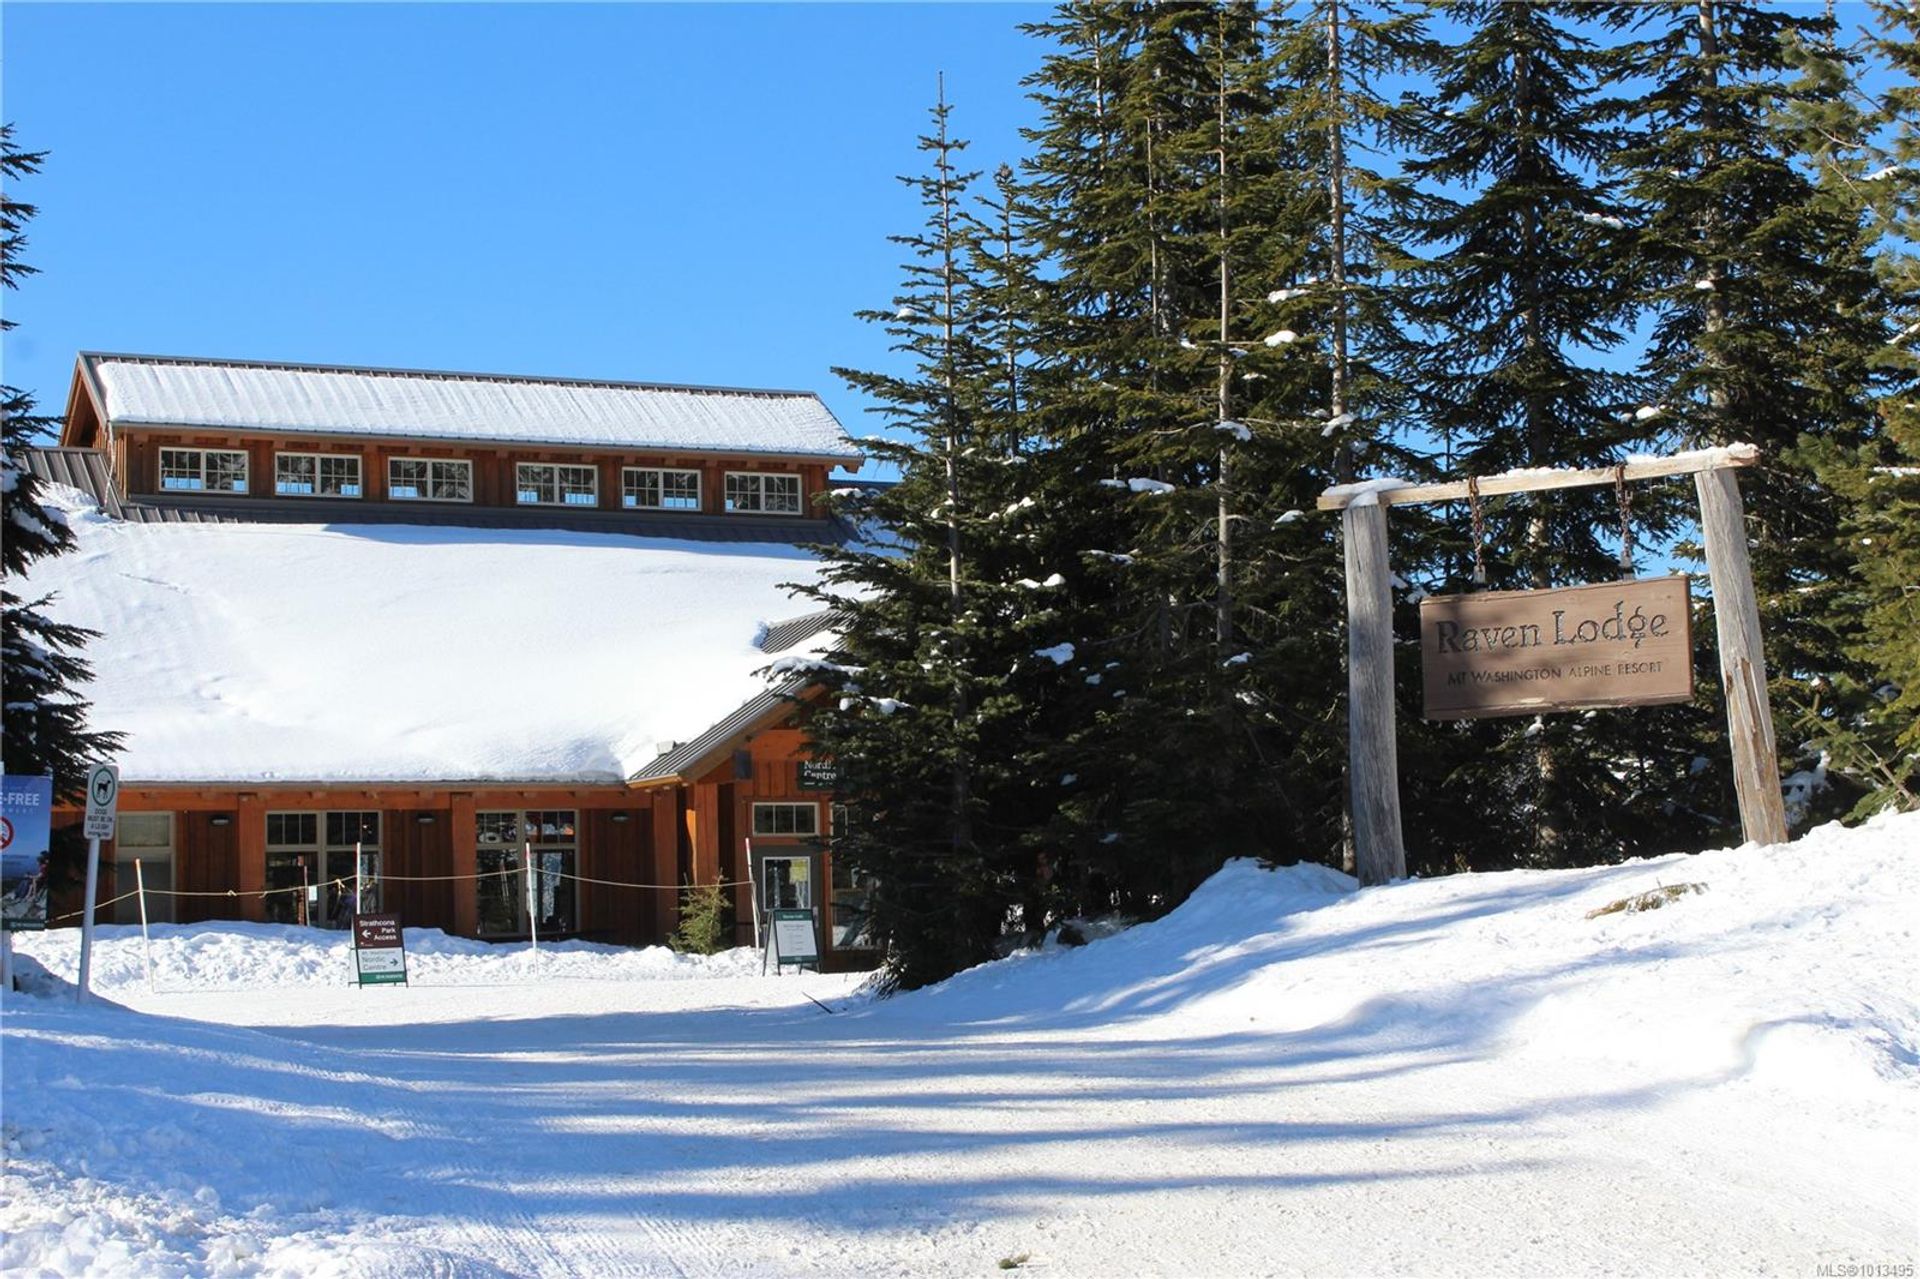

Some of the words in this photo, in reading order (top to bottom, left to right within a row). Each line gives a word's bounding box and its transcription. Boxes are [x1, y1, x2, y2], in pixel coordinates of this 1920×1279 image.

[1436, 620, 1541, 653] Raven
[1552, 600, 1669, 649] Lodge
[1471, 666, 1561, 684] WASHINGTON
[1569, 664, 1612, 679] ALPINE
[1617, 661, 1663, 676] RESORT
[804, 760, 836, 769] Nordi
